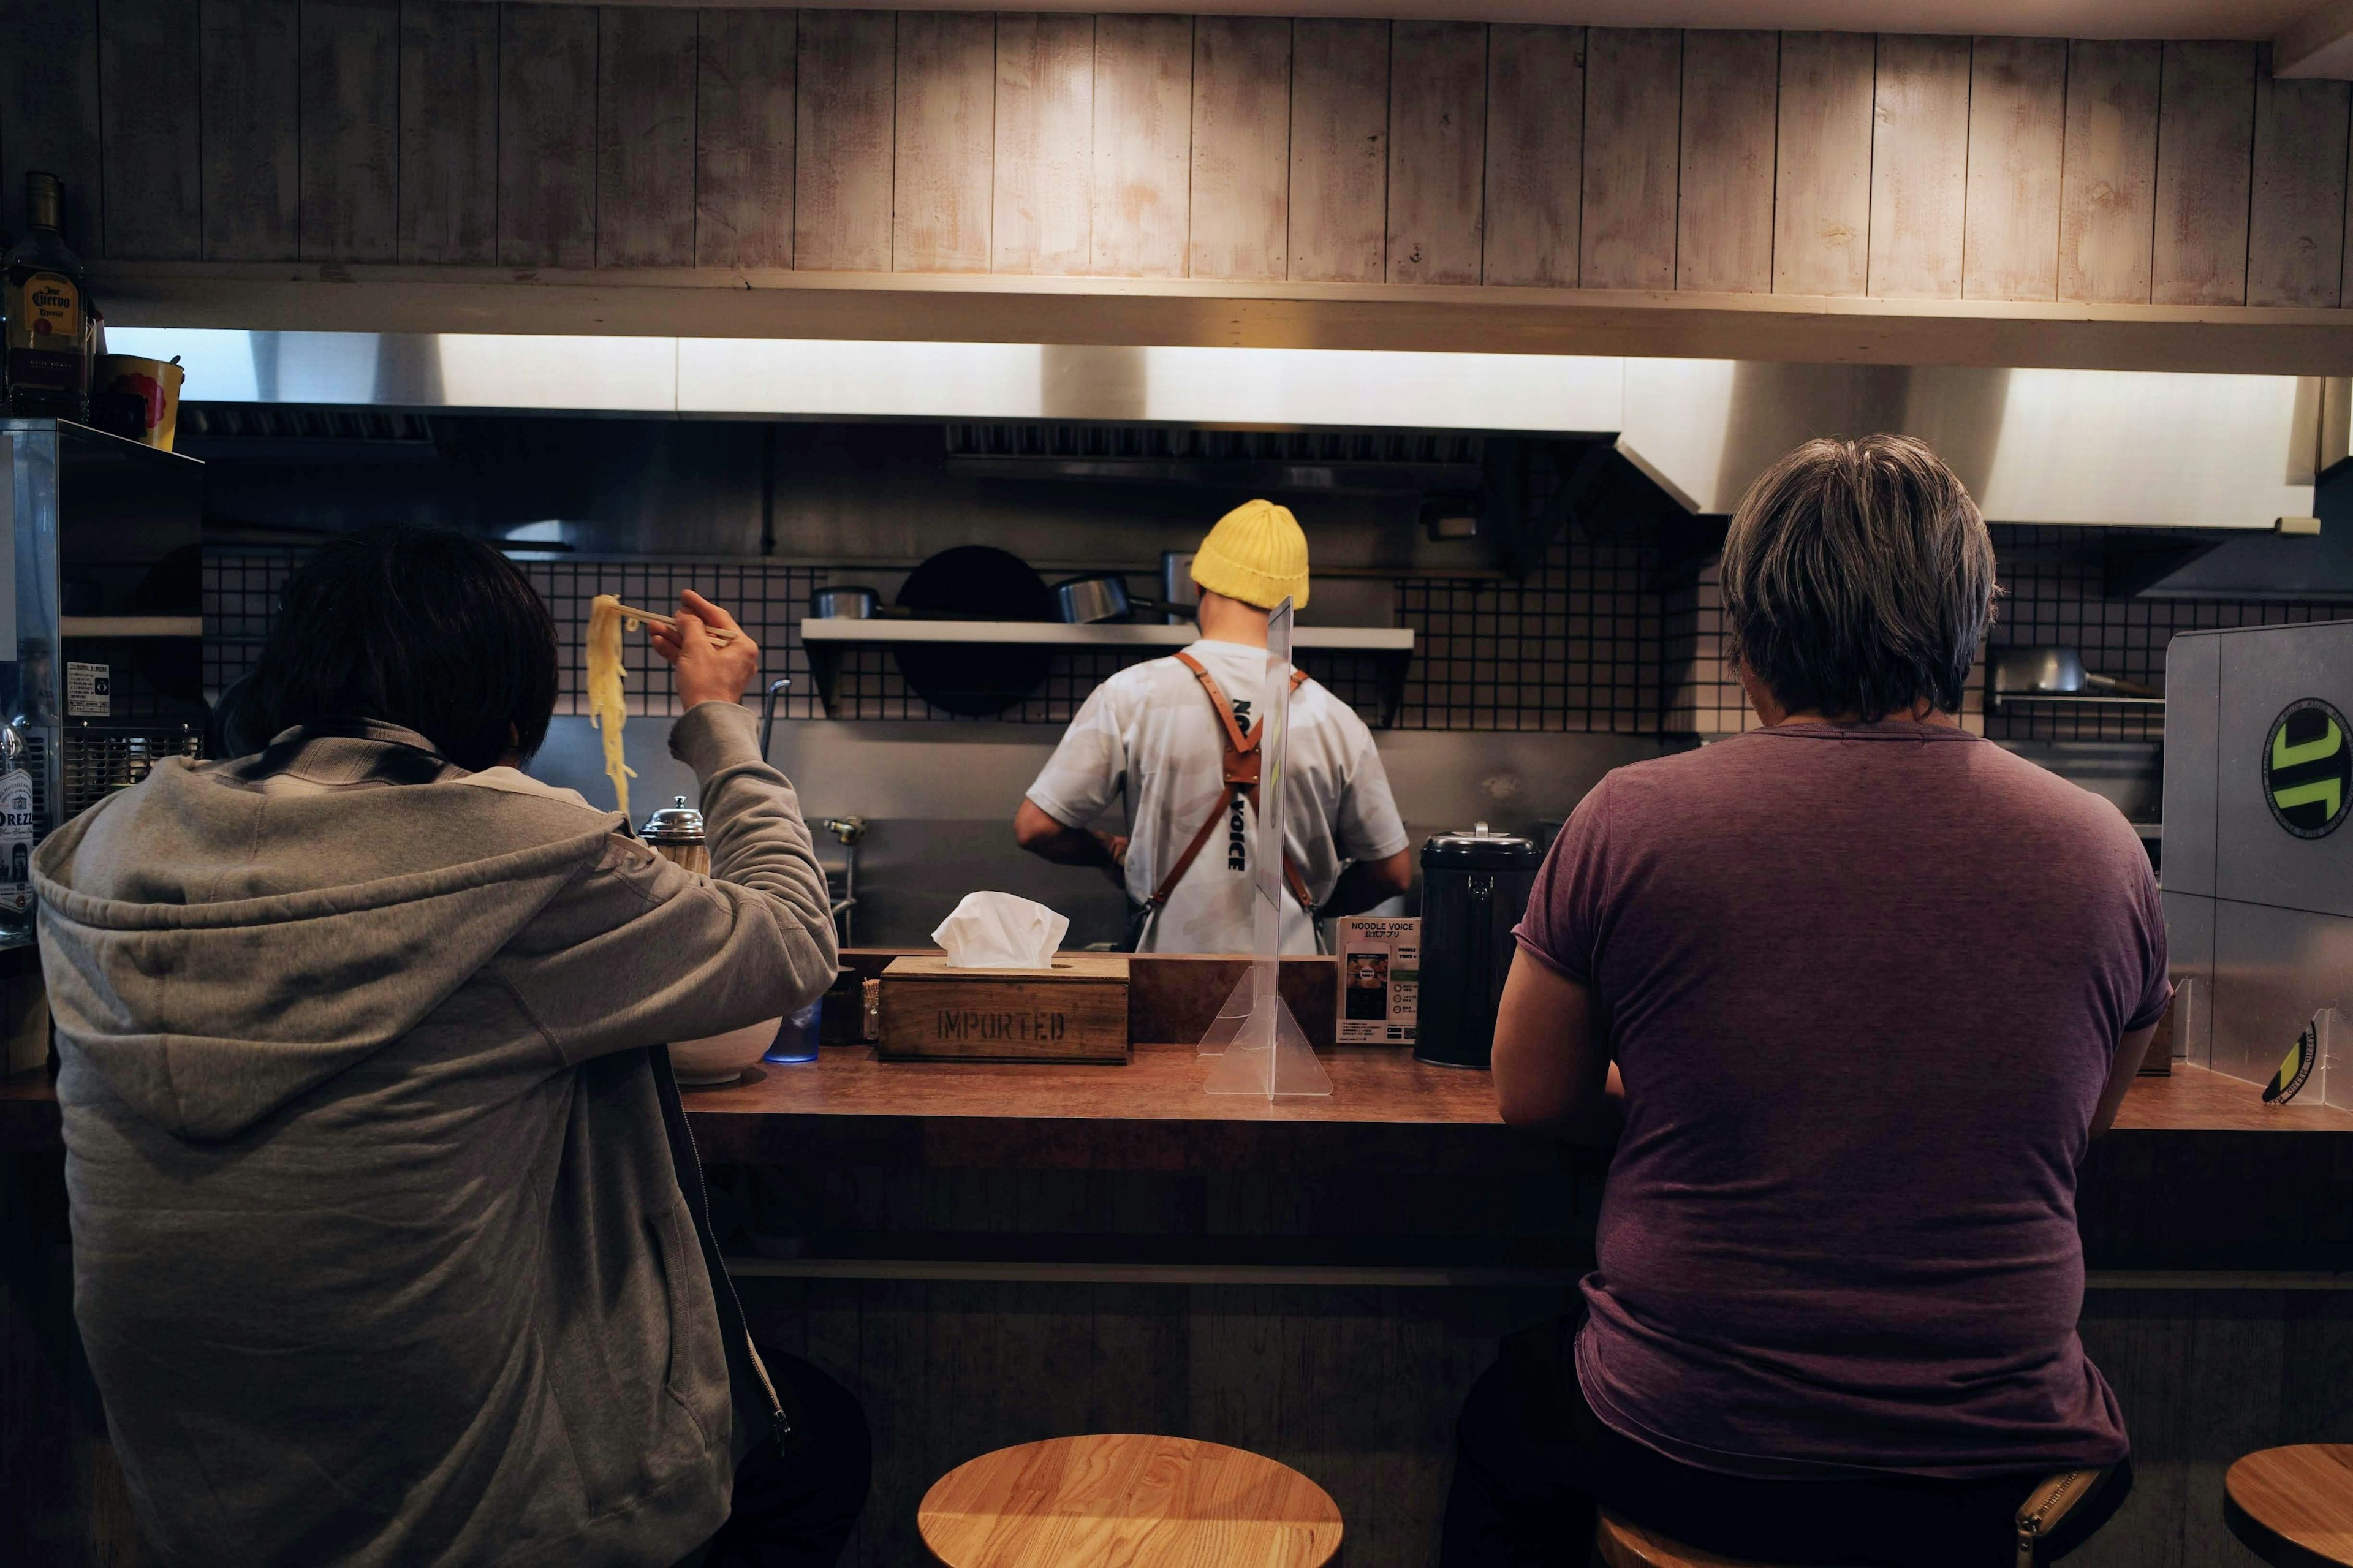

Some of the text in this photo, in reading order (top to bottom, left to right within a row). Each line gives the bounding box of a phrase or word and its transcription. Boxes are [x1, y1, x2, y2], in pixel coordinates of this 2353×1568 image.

[32, 292, 70, 308] Cuervo
[1228, 800, 1245, 871] VOICE
[938, 1010, 1064, 1040] IMPORTED
